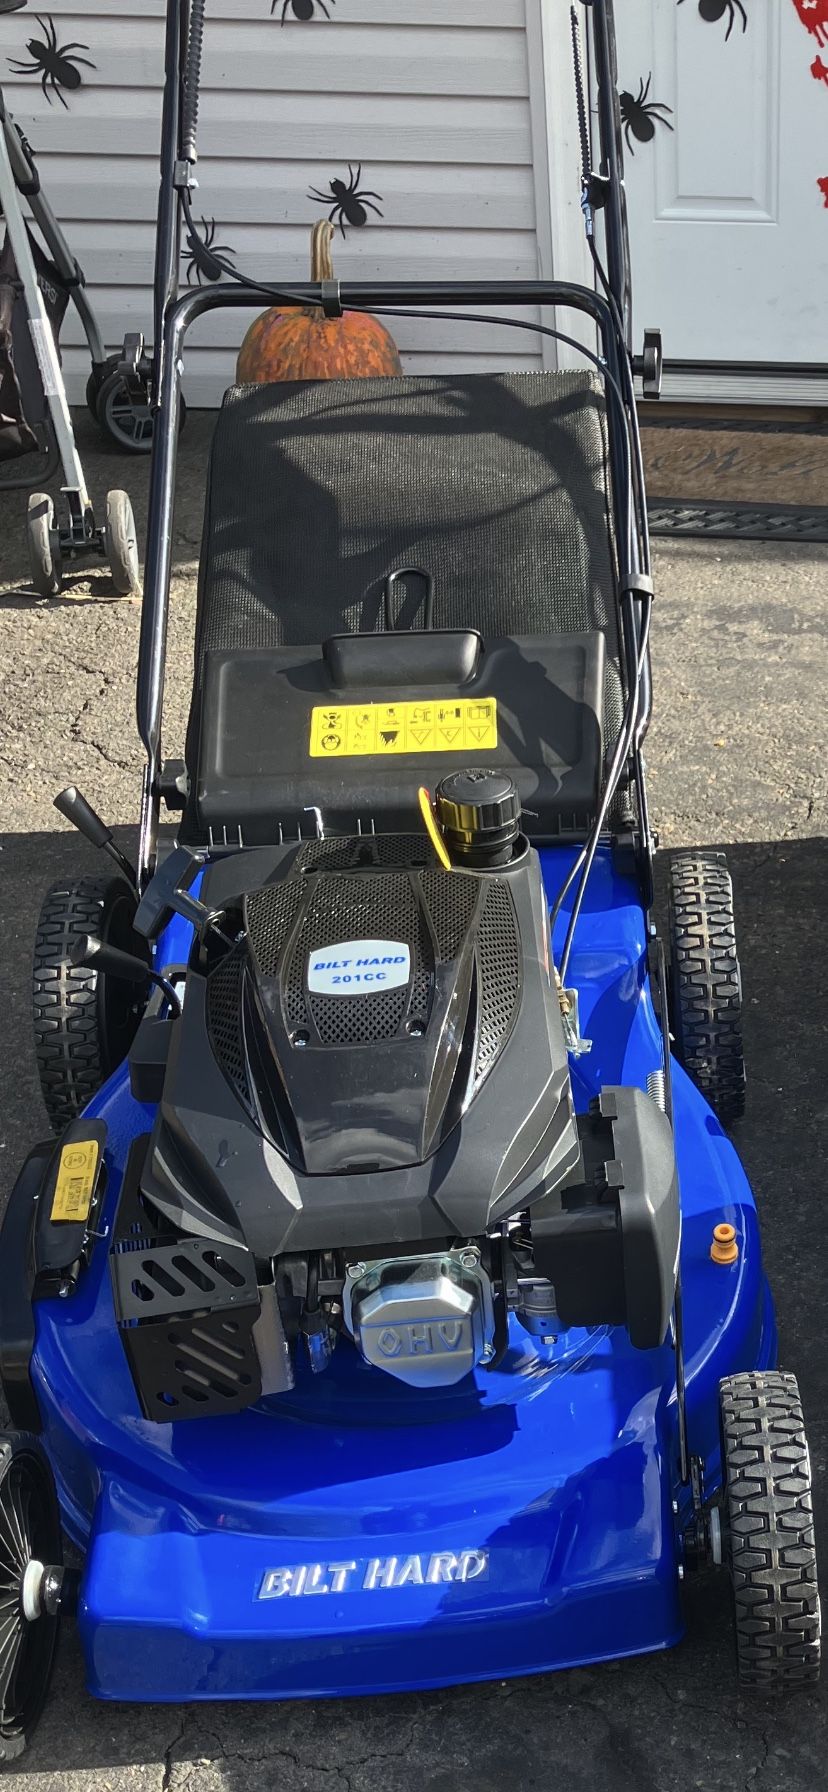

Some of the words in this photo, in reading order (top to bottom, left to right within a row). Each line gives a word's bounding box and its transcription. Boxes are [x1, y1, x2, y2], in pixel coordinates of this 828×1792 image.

[313, 960, 352, 970] BILT
[356, 956, 406, 967] HARD
[331, 972, 387, 984] 201CC
[377, 1320, 463, 1358] OHV
[258, 1561, 357, 1600] BILT
[361, 1549, 487, 1590] HARD
